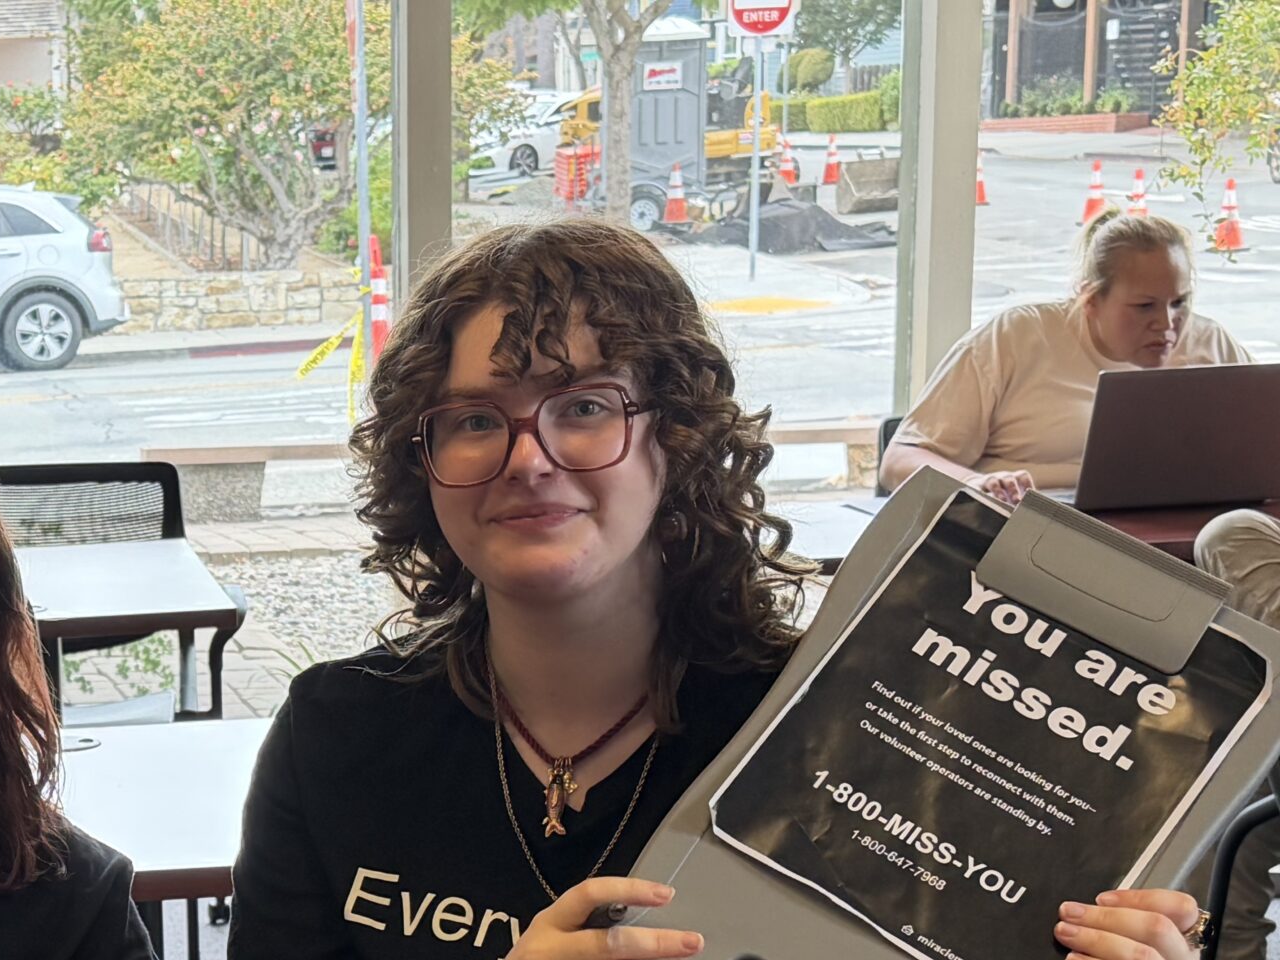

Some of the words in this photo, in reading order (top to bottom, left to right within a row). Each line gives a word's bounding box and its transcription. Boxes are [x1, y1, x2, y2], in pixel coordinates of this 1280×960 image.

[743, 11, 780, 22] ENTER
[911, 627, 1135, 771] missed.
[962, 570, 1067, 658] You
[1074, 649, 1177, 715] are
[859, 719, 880, 734] Our
[879, 731, 927, 762] volunteer
[926, 760, 974, 790] operators
[973, 787, 992, 800] are
[991, 797, 1037, 827] standing
[1036, 820, 1051, 835] by.
[865, 701, 878, 711] or
[877, 707, 899, 724] take
[899, 720, 917, 735] the
[916, 730, 938, 747] first
[936, 743, 960, 759] step
[960, 755, 972, 766] to
[971, 763, 1022, 795] reconnect
[1022, 791, 1046, 808] with
[1046, 804, 1075, 826] them.
[871, 680, 896, 699] Find
[893, 696, 912, 710] out
[911, 704, 923, 714] if
[918, 710, 944, 727] your
[943, 722, 974, 744] loved
[971, 740, 997, 758] ones
[996, 755, 1014, 768] are
[1013, 762, 1054, 791] looking
[1052, 785, 1070, 798] for
[811, 769, 1027, 904] 1-800-MISS-YOU
[851, 829, 947, 891] 1-800-647-7968
